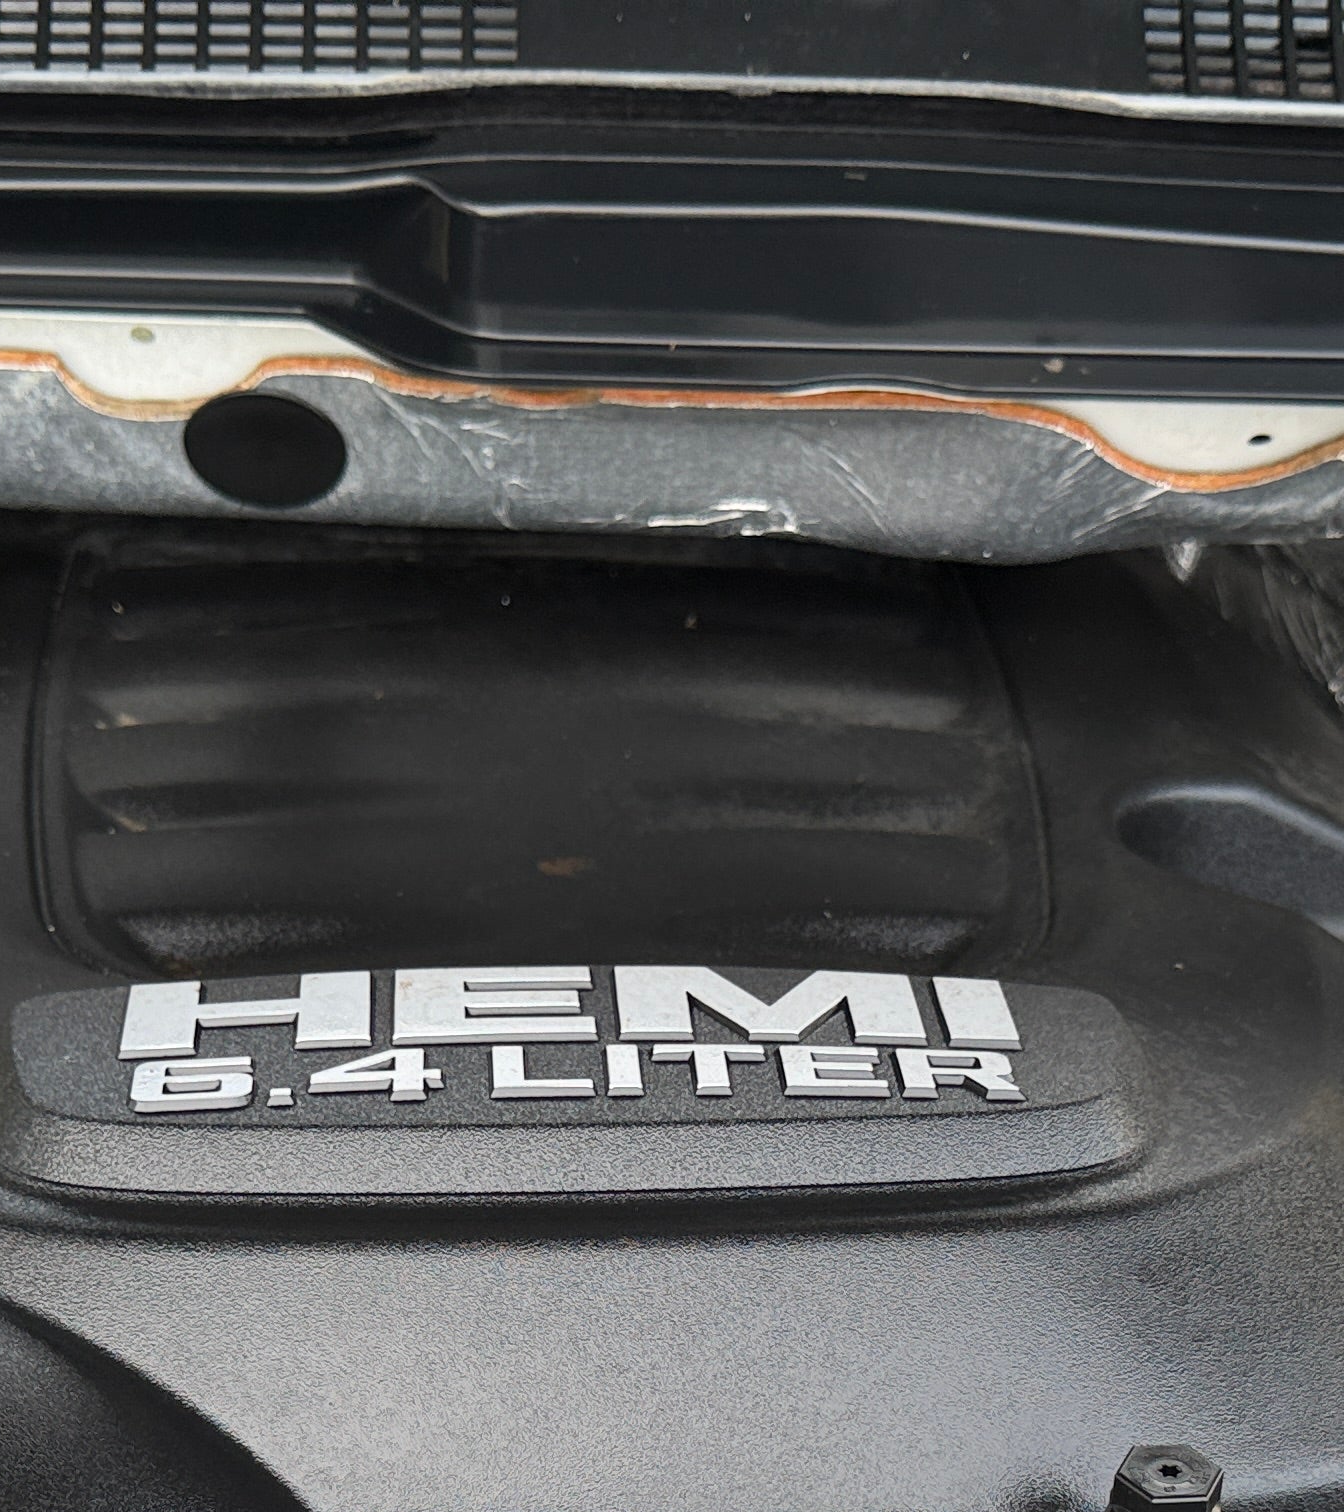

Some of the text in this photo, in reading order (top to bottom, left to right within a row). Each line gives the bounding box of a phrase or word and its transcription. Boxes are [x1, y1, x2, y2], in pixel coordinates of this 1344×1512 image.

[118, 965, 1024, 1058] HEMI
[130, 1043, 1028, 1114] 6.4 LITER
